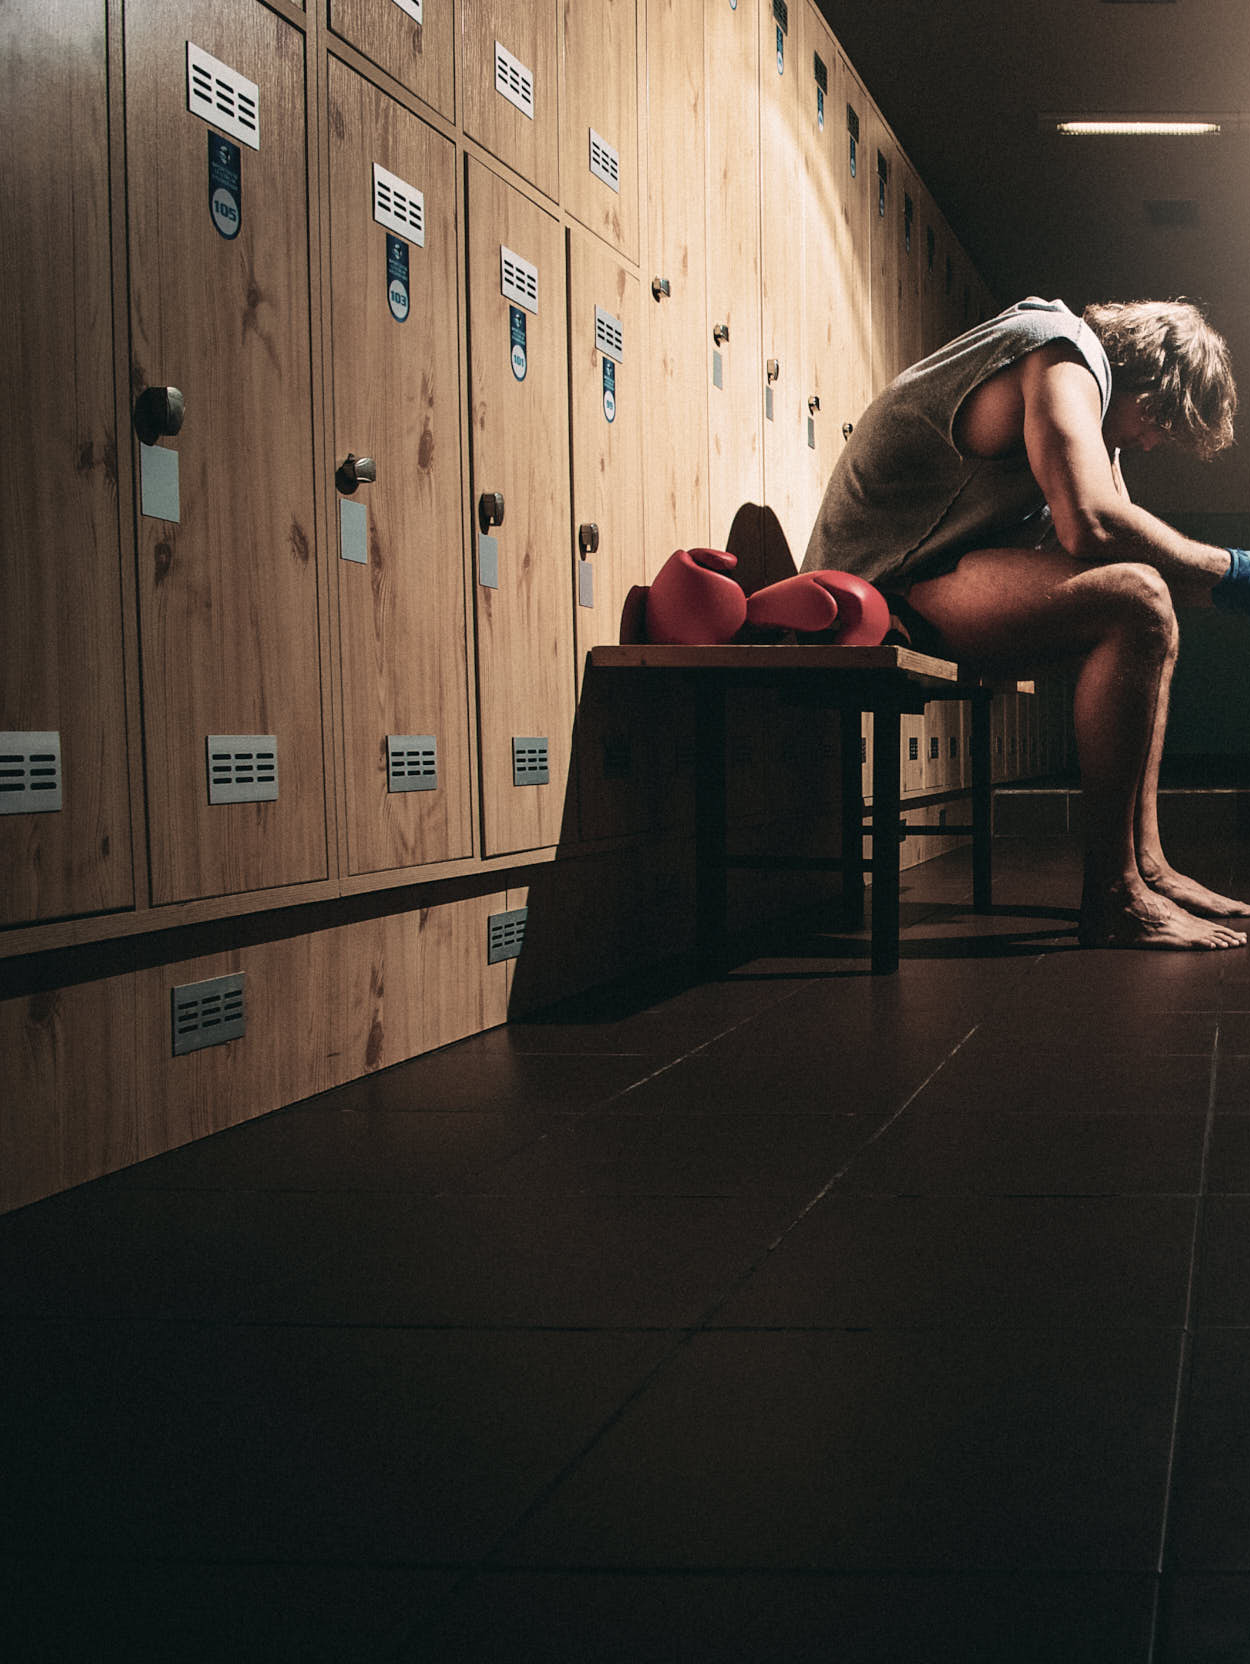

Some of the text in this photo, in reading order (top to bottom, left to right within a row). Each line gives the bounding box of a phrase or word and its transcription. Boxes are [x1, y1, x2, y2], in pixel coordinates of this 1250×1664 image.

[214, 200, 237, 222] 105
[391, 290, 407, 307] 103
[513, 354, 524, 368] 101
